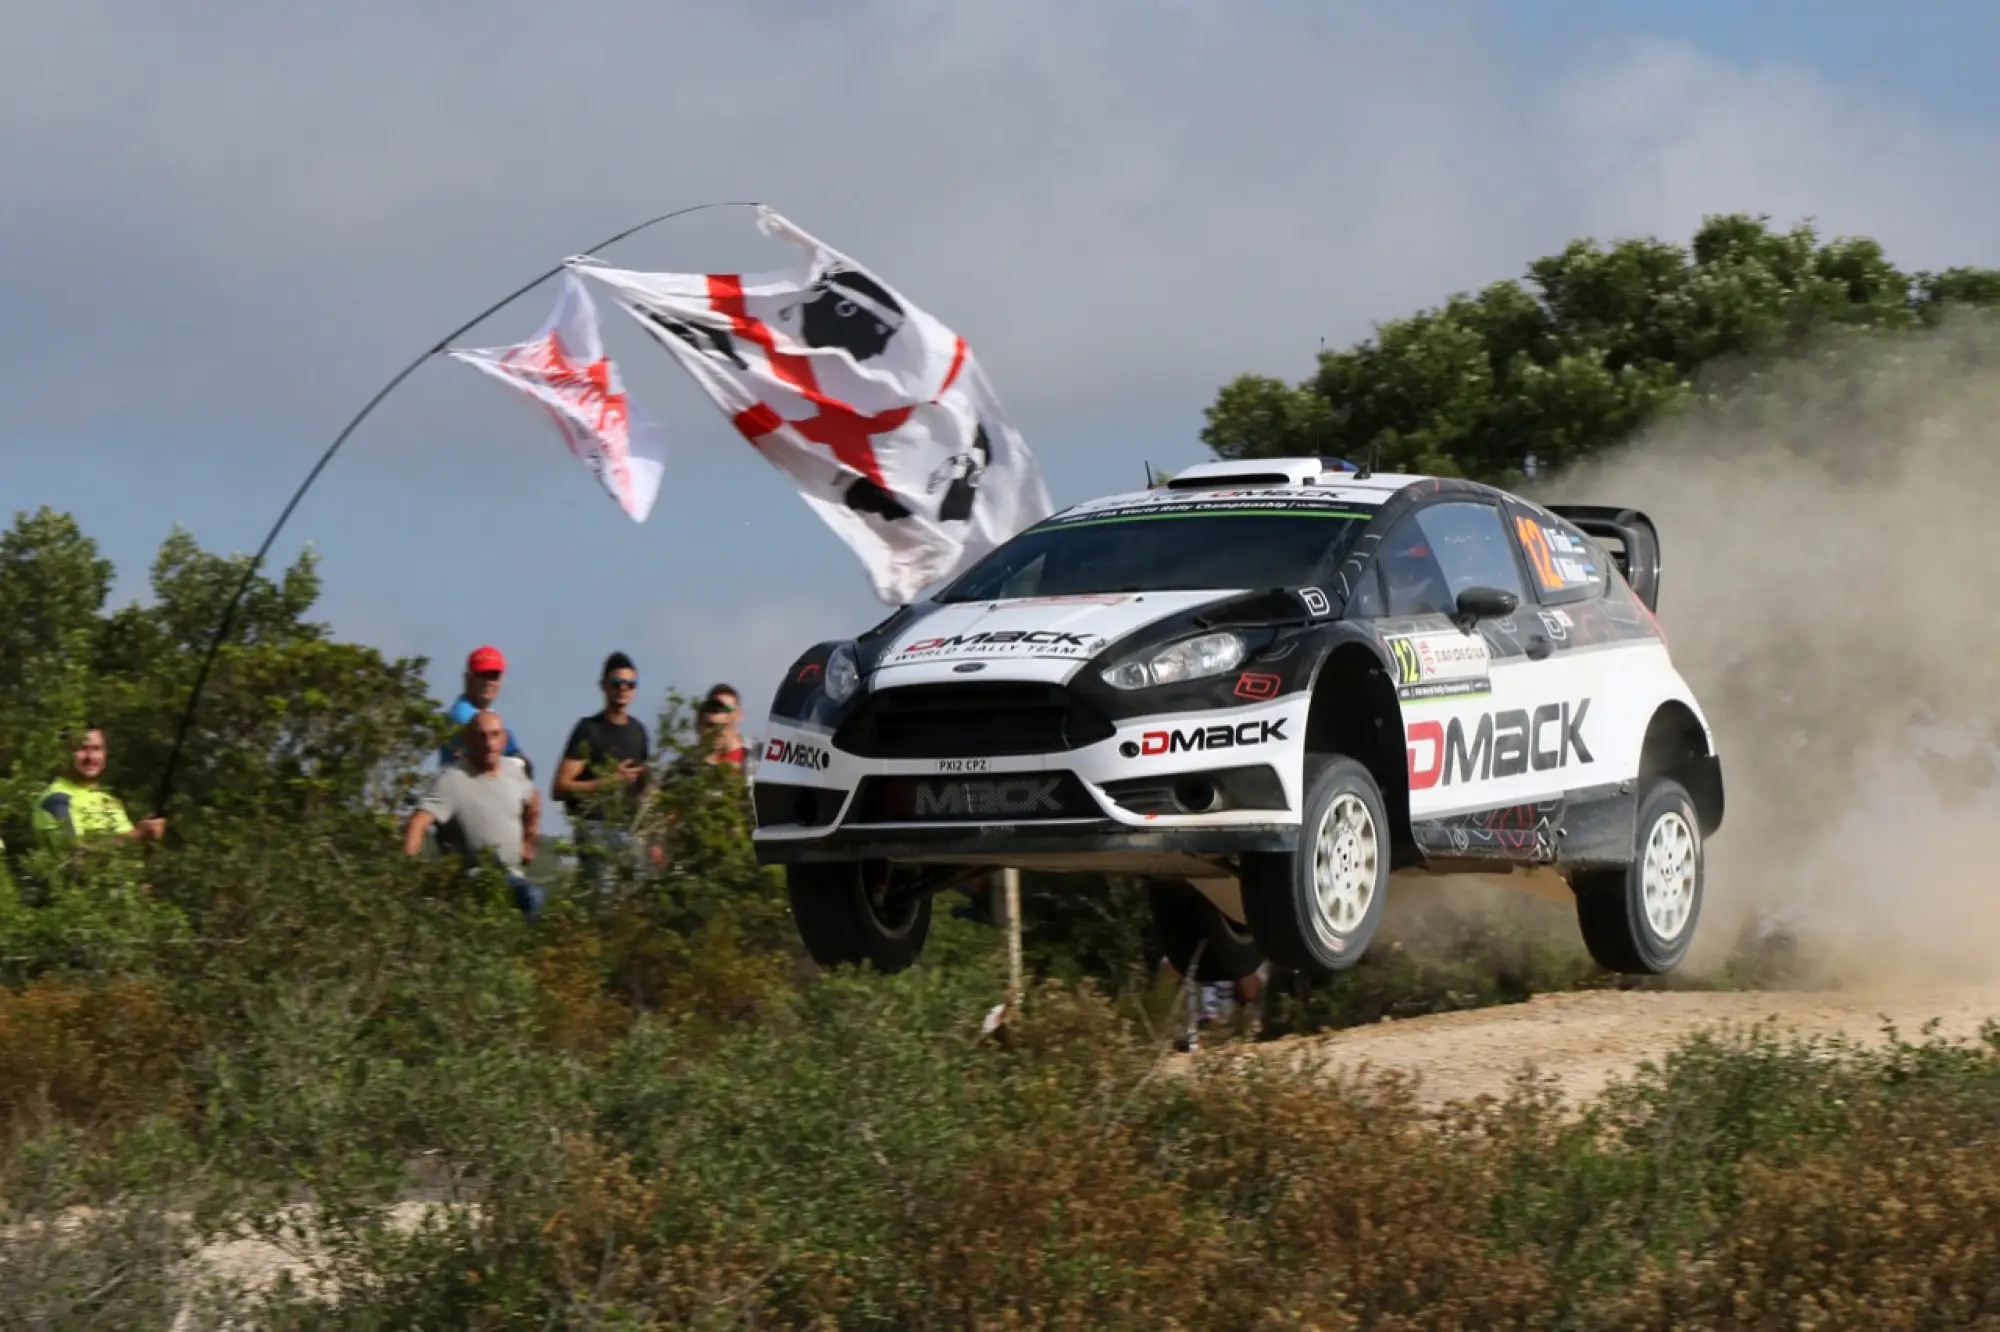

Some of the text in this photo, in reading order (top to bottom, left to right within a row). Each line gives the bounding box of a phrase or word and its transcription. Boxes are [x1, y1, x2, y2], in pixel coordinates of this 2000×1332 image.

[1515, 515, 1564, 590] 12
[894, 644, 1078, 661] WORLD RALLY TEAM
[1393, 639, 1419, 684] 12
[939, 759, 987, 772] PX12 CPZ
